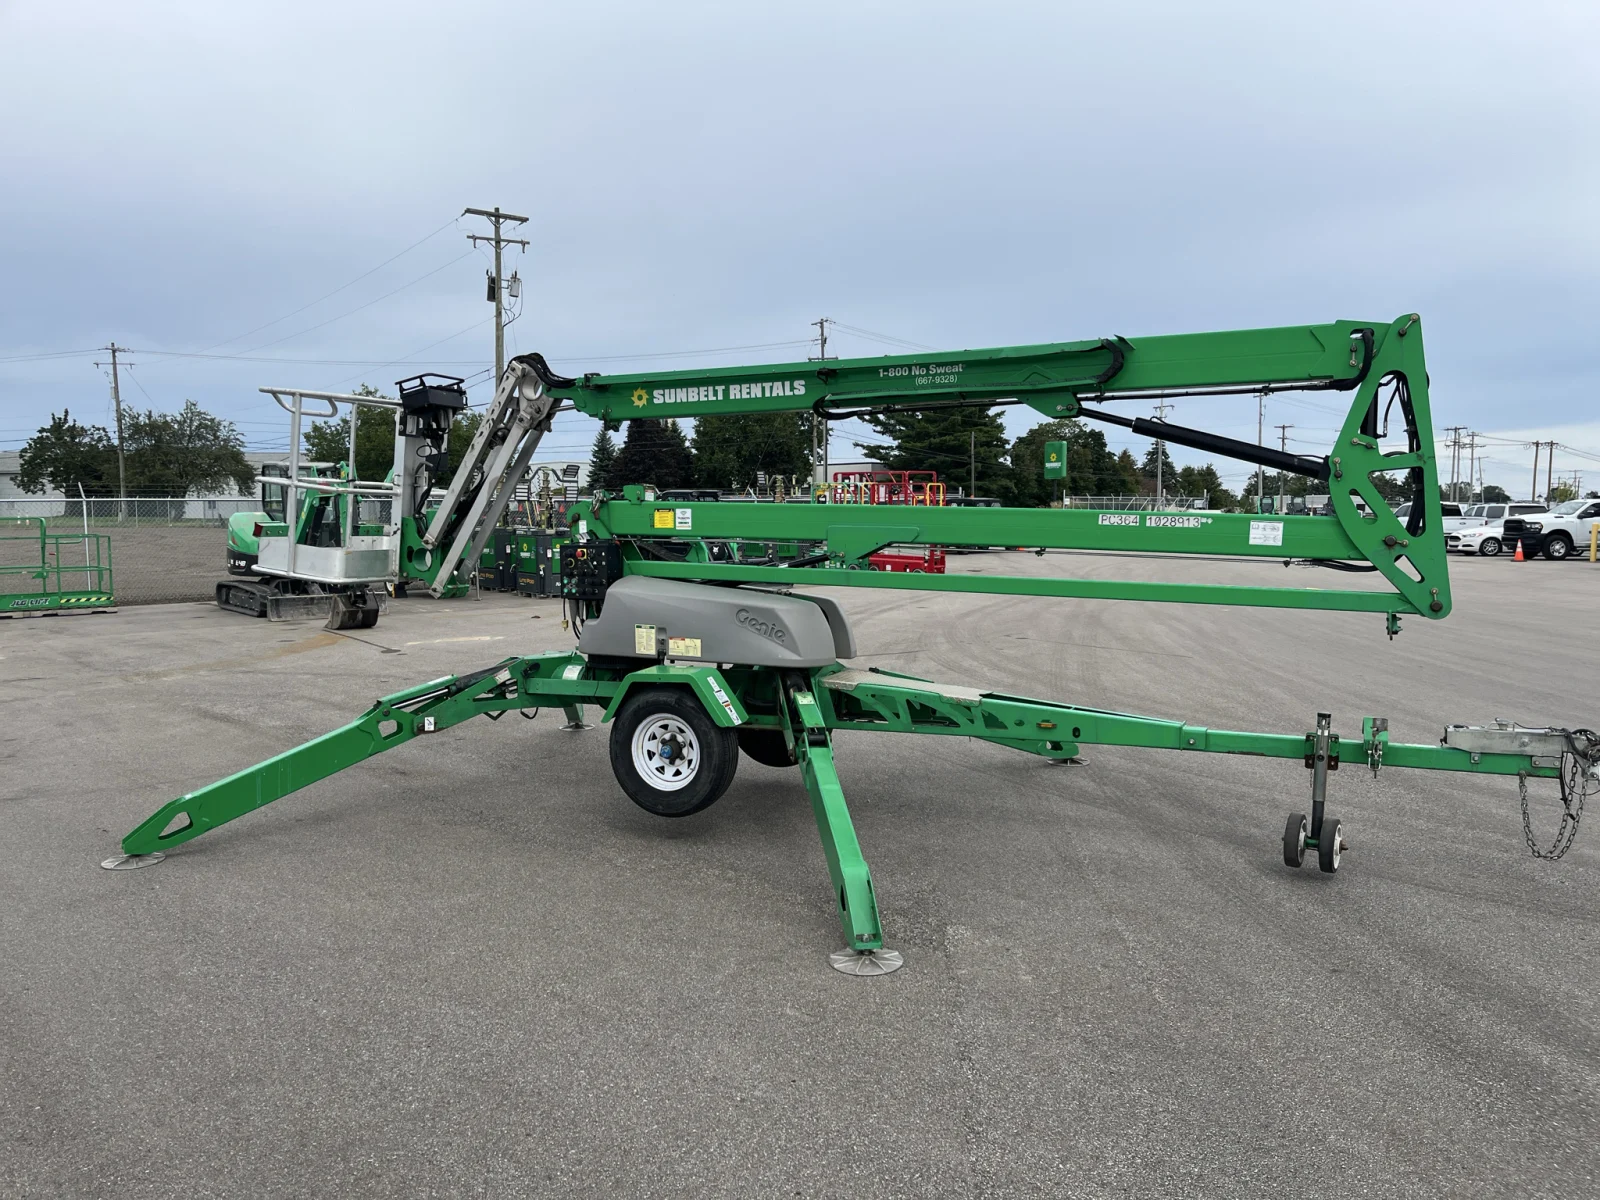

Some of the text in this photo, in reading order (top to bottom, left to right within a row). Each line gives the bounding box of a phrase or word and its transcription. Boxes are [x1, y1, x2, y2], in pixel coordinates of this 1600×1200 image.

[878, 363, 964, 378] 1-800 No Sweat
[915, 374, 958, 386] (667-9328)
[653, 380, 806, 404] SUNBELT RENTALS
[1100, 514, 1200, 528] PC364 1028913
[9, 597, 50, 608] JLG LIFT
[735, 608, 786, 645] Genie
